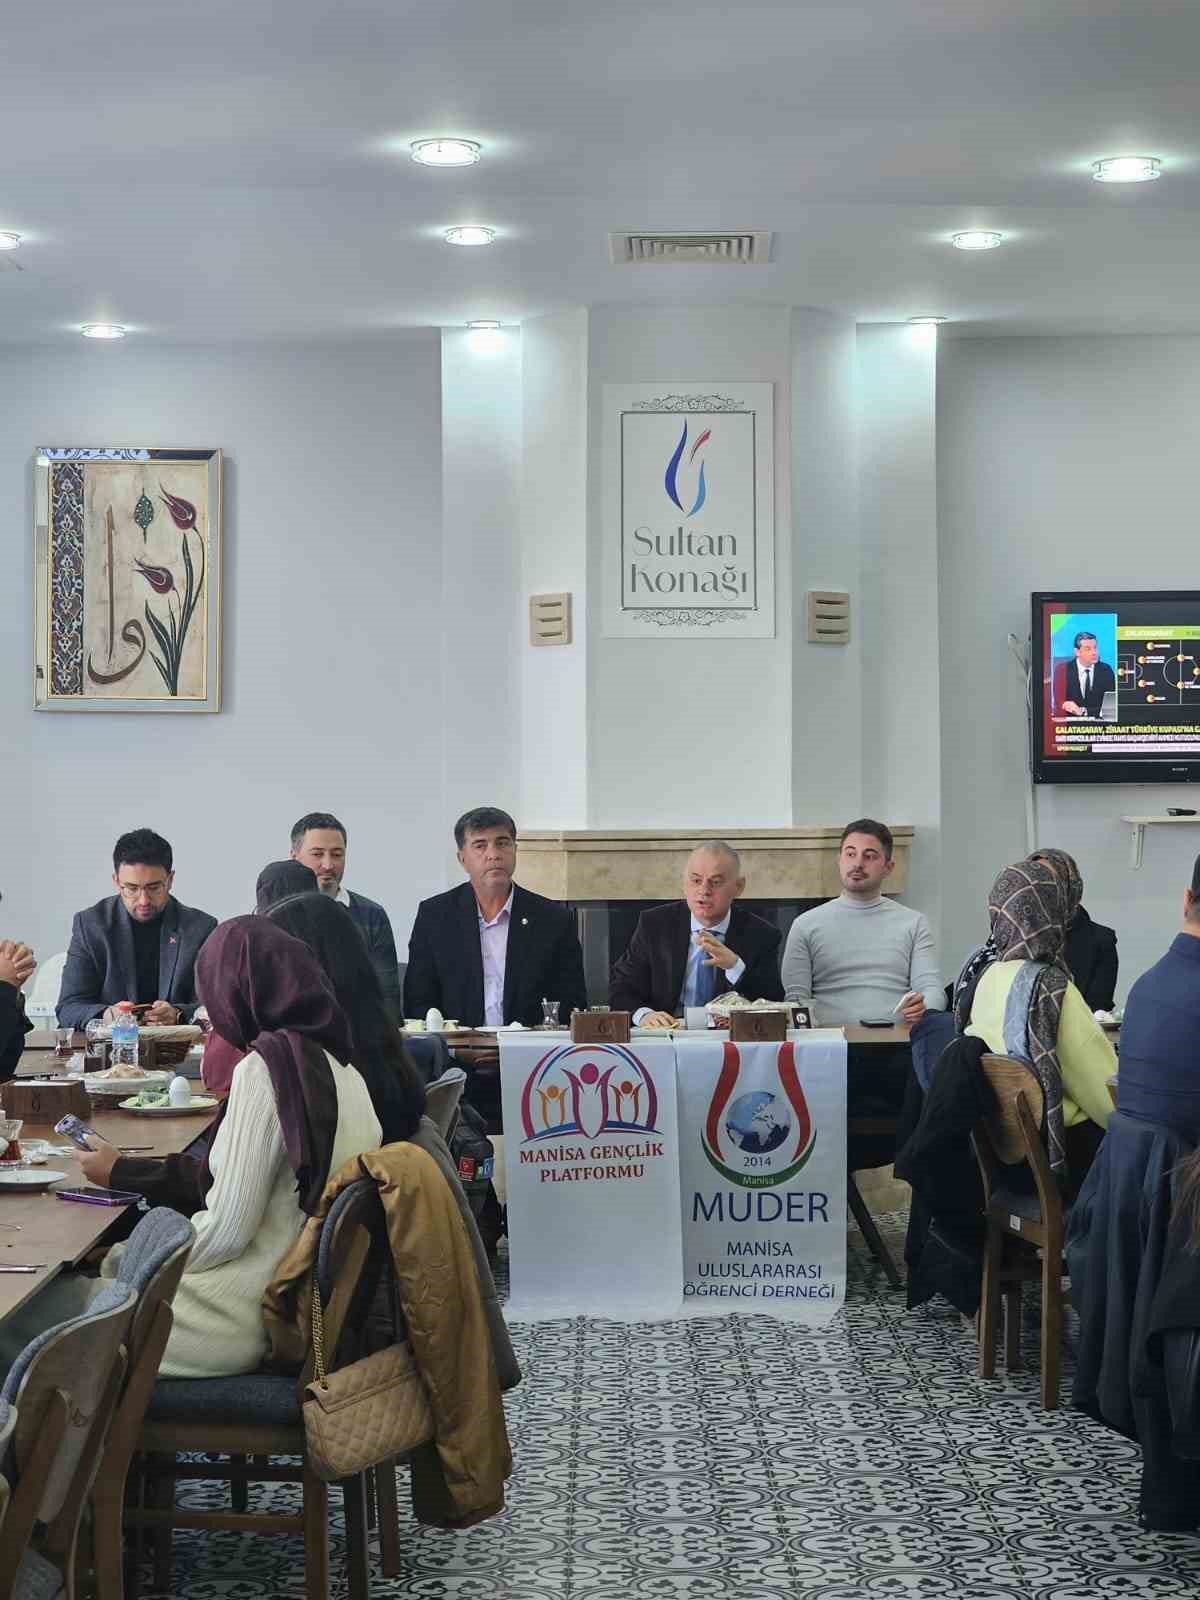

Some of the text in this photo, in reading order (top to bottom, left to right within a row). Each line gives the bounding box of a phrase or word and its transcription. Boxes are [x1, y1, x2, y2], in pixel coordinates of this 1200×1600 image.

[633, 526, 737, 557] Sultan
[631, 563, 748, 602] Konağı
[519, 1142, 664, 1164] MANİSA GENÇLİK
[743, 1156, 772, 1168] 2014
[540, 1164, 645, 1183] PLATFORMU
[742, 1175, 775, 1186] Manisa
[692, 1192, 829, 1223] MUDER
[727, 1240, 793, 1257] MANİSA
[698, 1263, 822, 1279] ULUSLARARASI
[683, 1281, 836, 1299] ÖĞRENCİ DERNEĞİ
